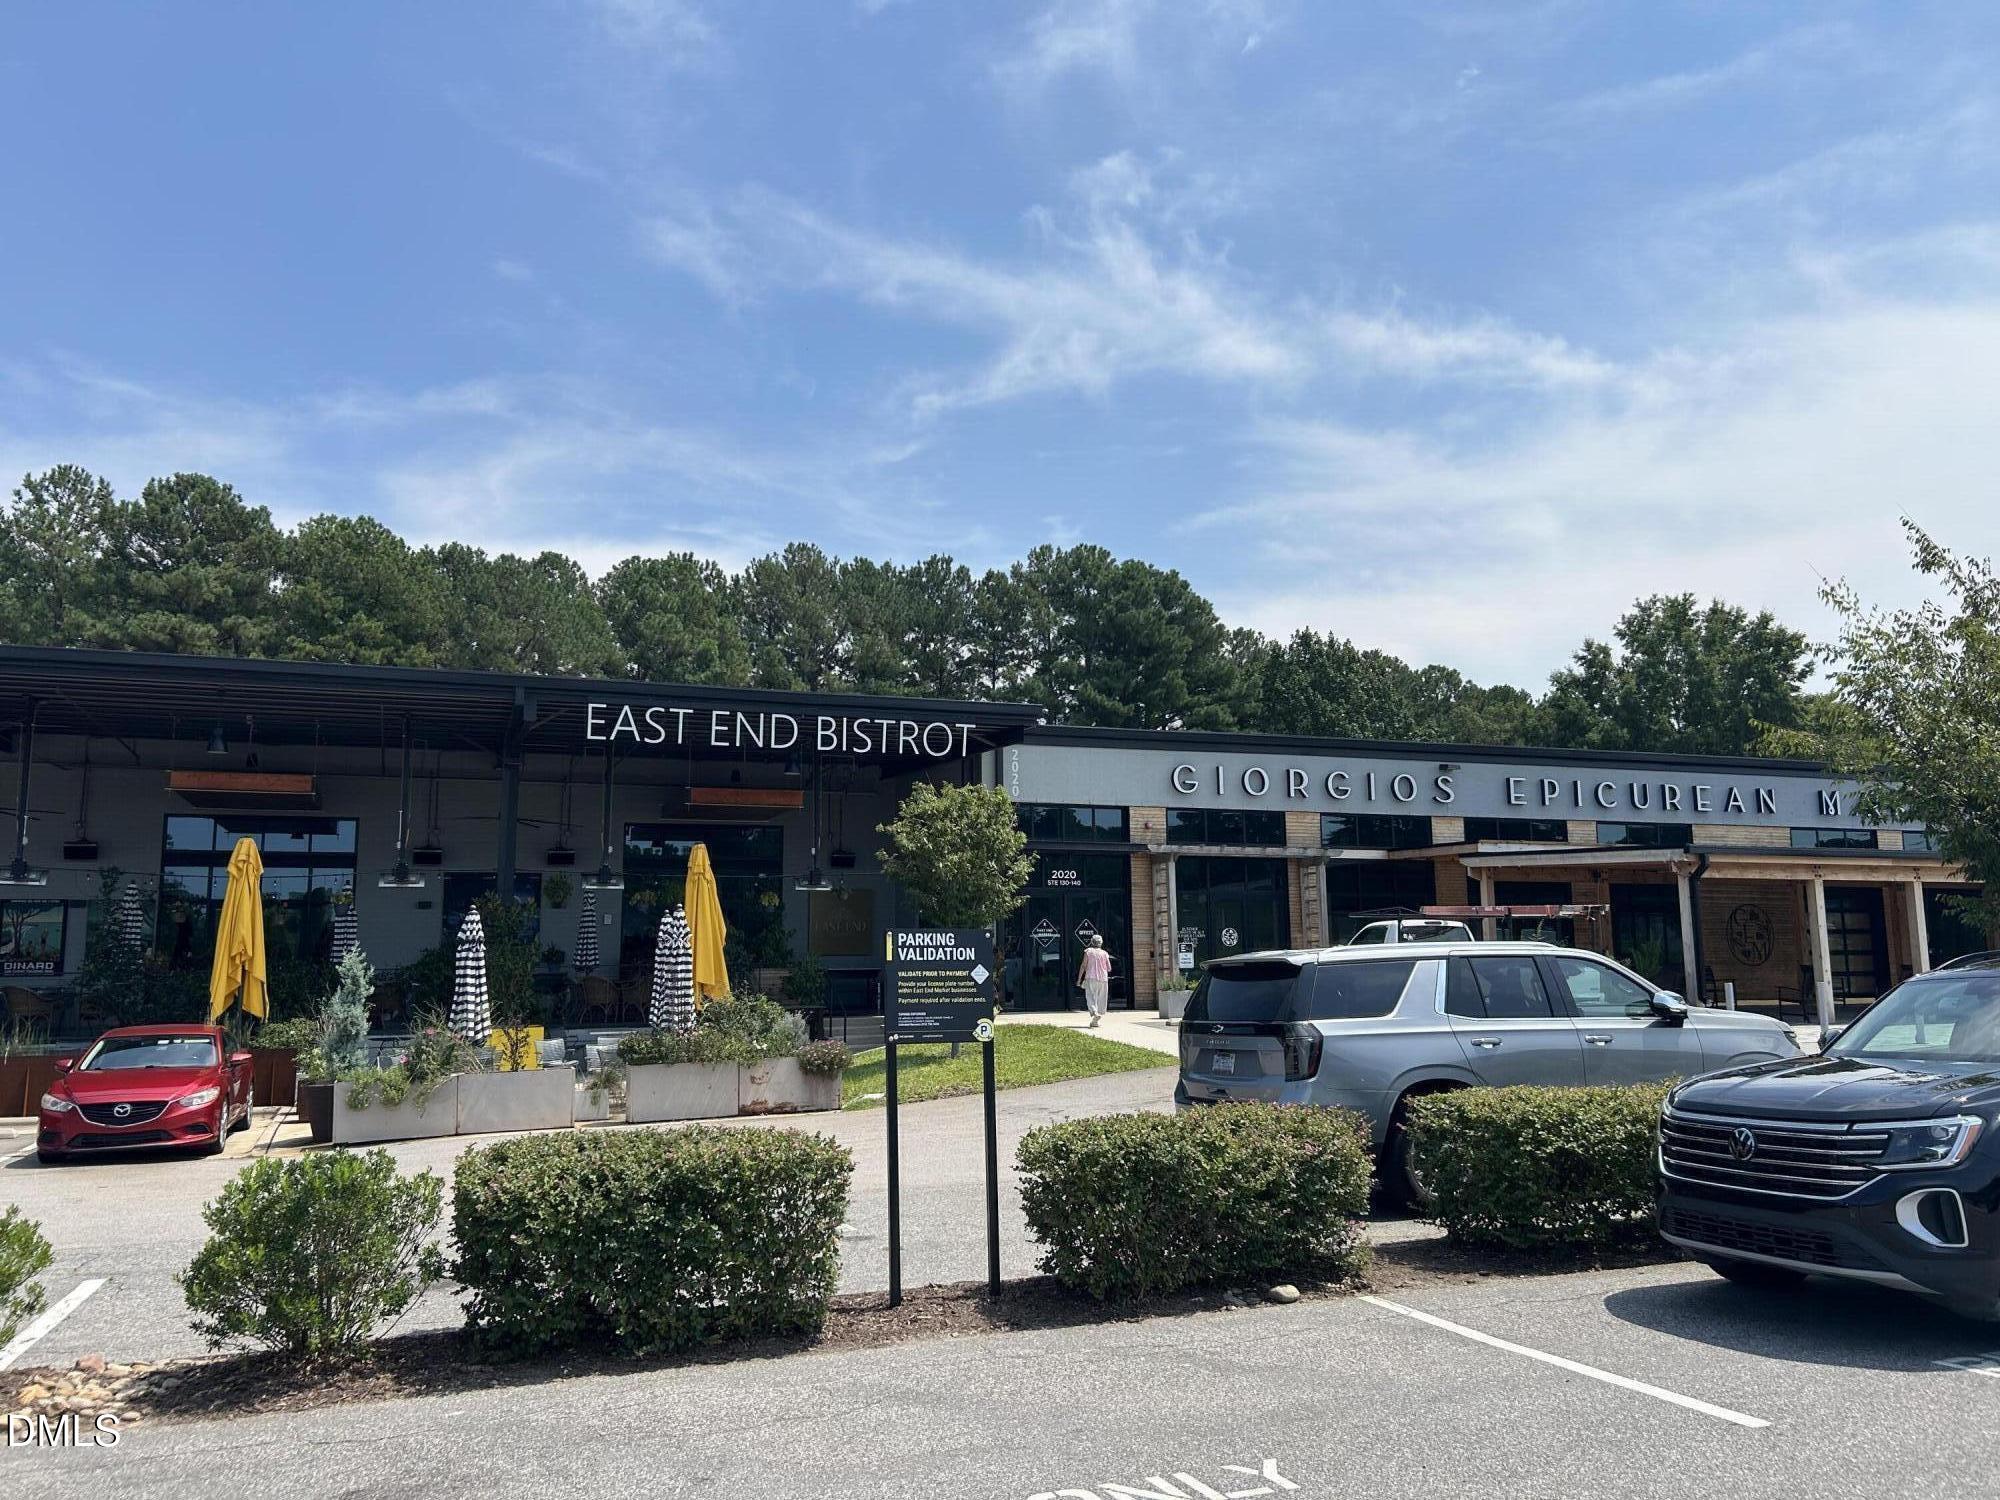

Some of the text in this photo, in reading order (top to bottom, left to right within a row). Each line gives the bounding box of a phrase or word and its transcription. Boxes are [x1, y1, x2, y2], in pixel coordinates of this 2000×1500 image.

[586, 703, 976, 757] EAST END BISTROT
[1011, 749, 1020, 797] 2020
[1171, 764, 1456, 803] GIORGIOS
[1505, 777, 1776, 814] EPICUREAN
[1051, 870, 1077, 879] 2020
[898, 932, 955, 946] PARKING
[897, 947, 975, 961] VALIDATION
[981, 1025, 987, 1035] P
